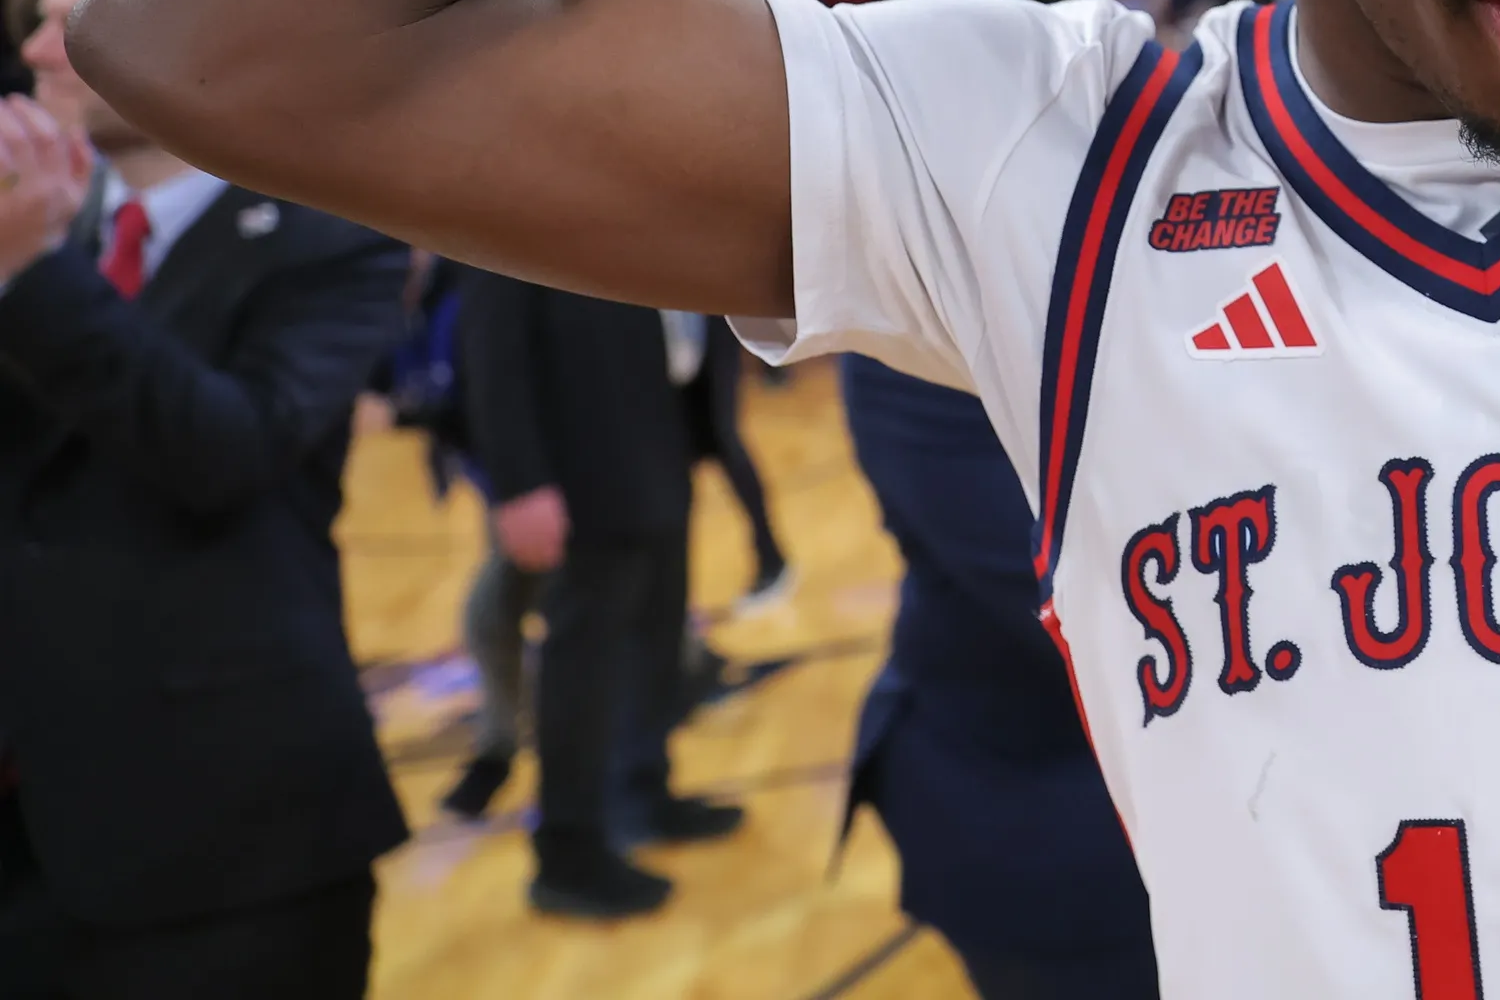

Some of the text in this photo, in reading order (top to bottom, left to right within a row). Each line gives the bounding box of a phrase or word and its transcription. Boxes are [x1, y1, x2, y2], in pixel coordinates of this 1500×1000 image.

[1167, 188, 1278, 222] BE THE
[1150, 214, 1278, 250] CHANGE
[1121, 484, 1302, 727] ST.
